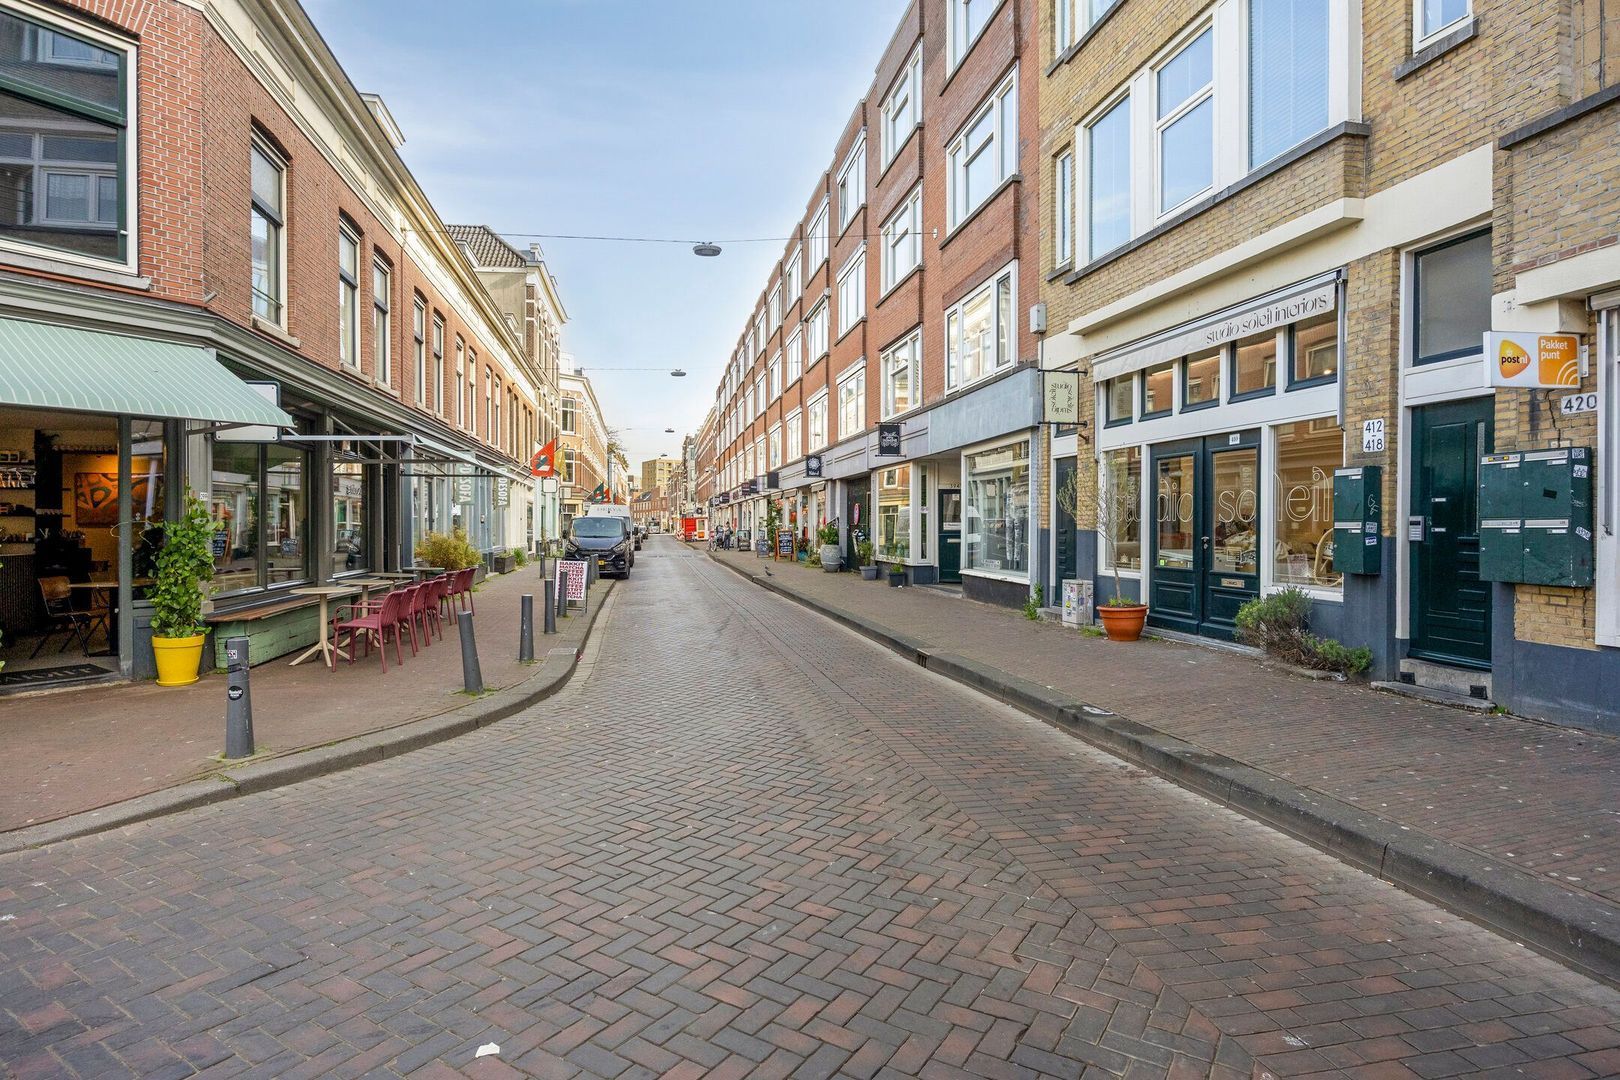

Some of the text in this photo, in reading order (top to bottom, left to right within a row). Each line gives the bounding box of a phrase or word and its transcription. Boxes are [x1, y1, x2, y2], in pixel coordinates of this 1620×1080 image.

[1206, 294, 1327, 344] studio soleil interiors
[1540, 340, 1568, 350] Pakket
[1501, 354, 1527, 365] postnl
[1540, 351, 1560, 361] punt
[1564, 394, 1597, 413] 420
[1365, 420, 1382, 434] 412
[1365, 438, 1383, 451] 418
[498, 467, 508, 506] ODESOFA
[1218, 466, 1330, 523] soleil
